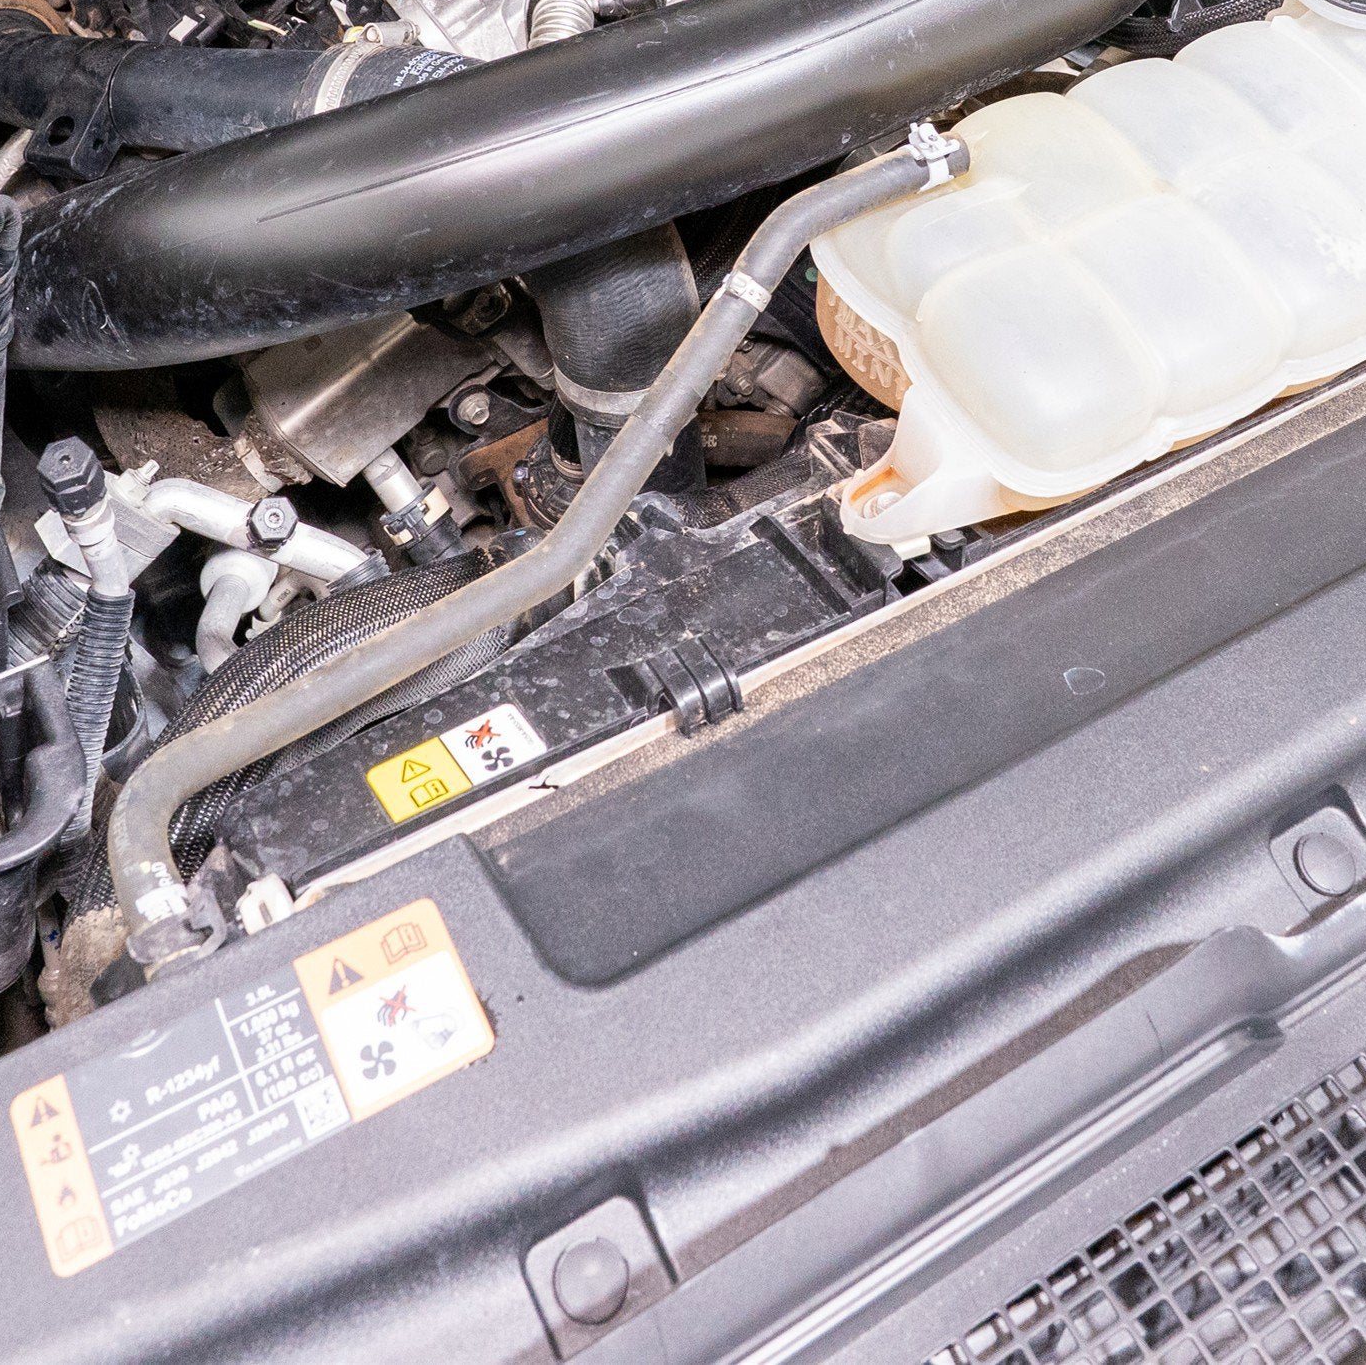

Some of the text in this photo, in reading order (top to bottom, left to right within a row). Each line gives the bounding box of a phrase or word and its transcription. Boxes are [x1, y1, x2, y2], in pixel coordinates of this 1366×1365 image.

[833, 321, 895, 389] MIN
[148, 862, 173, 889] RAD
[257, 1025, 272, 1045] 37
[145, 1055, 219, 1105] R-1234yf
[197, 1091, 237, 1121] PAG
[114, 1187, 192, 1237] FoMoCo
